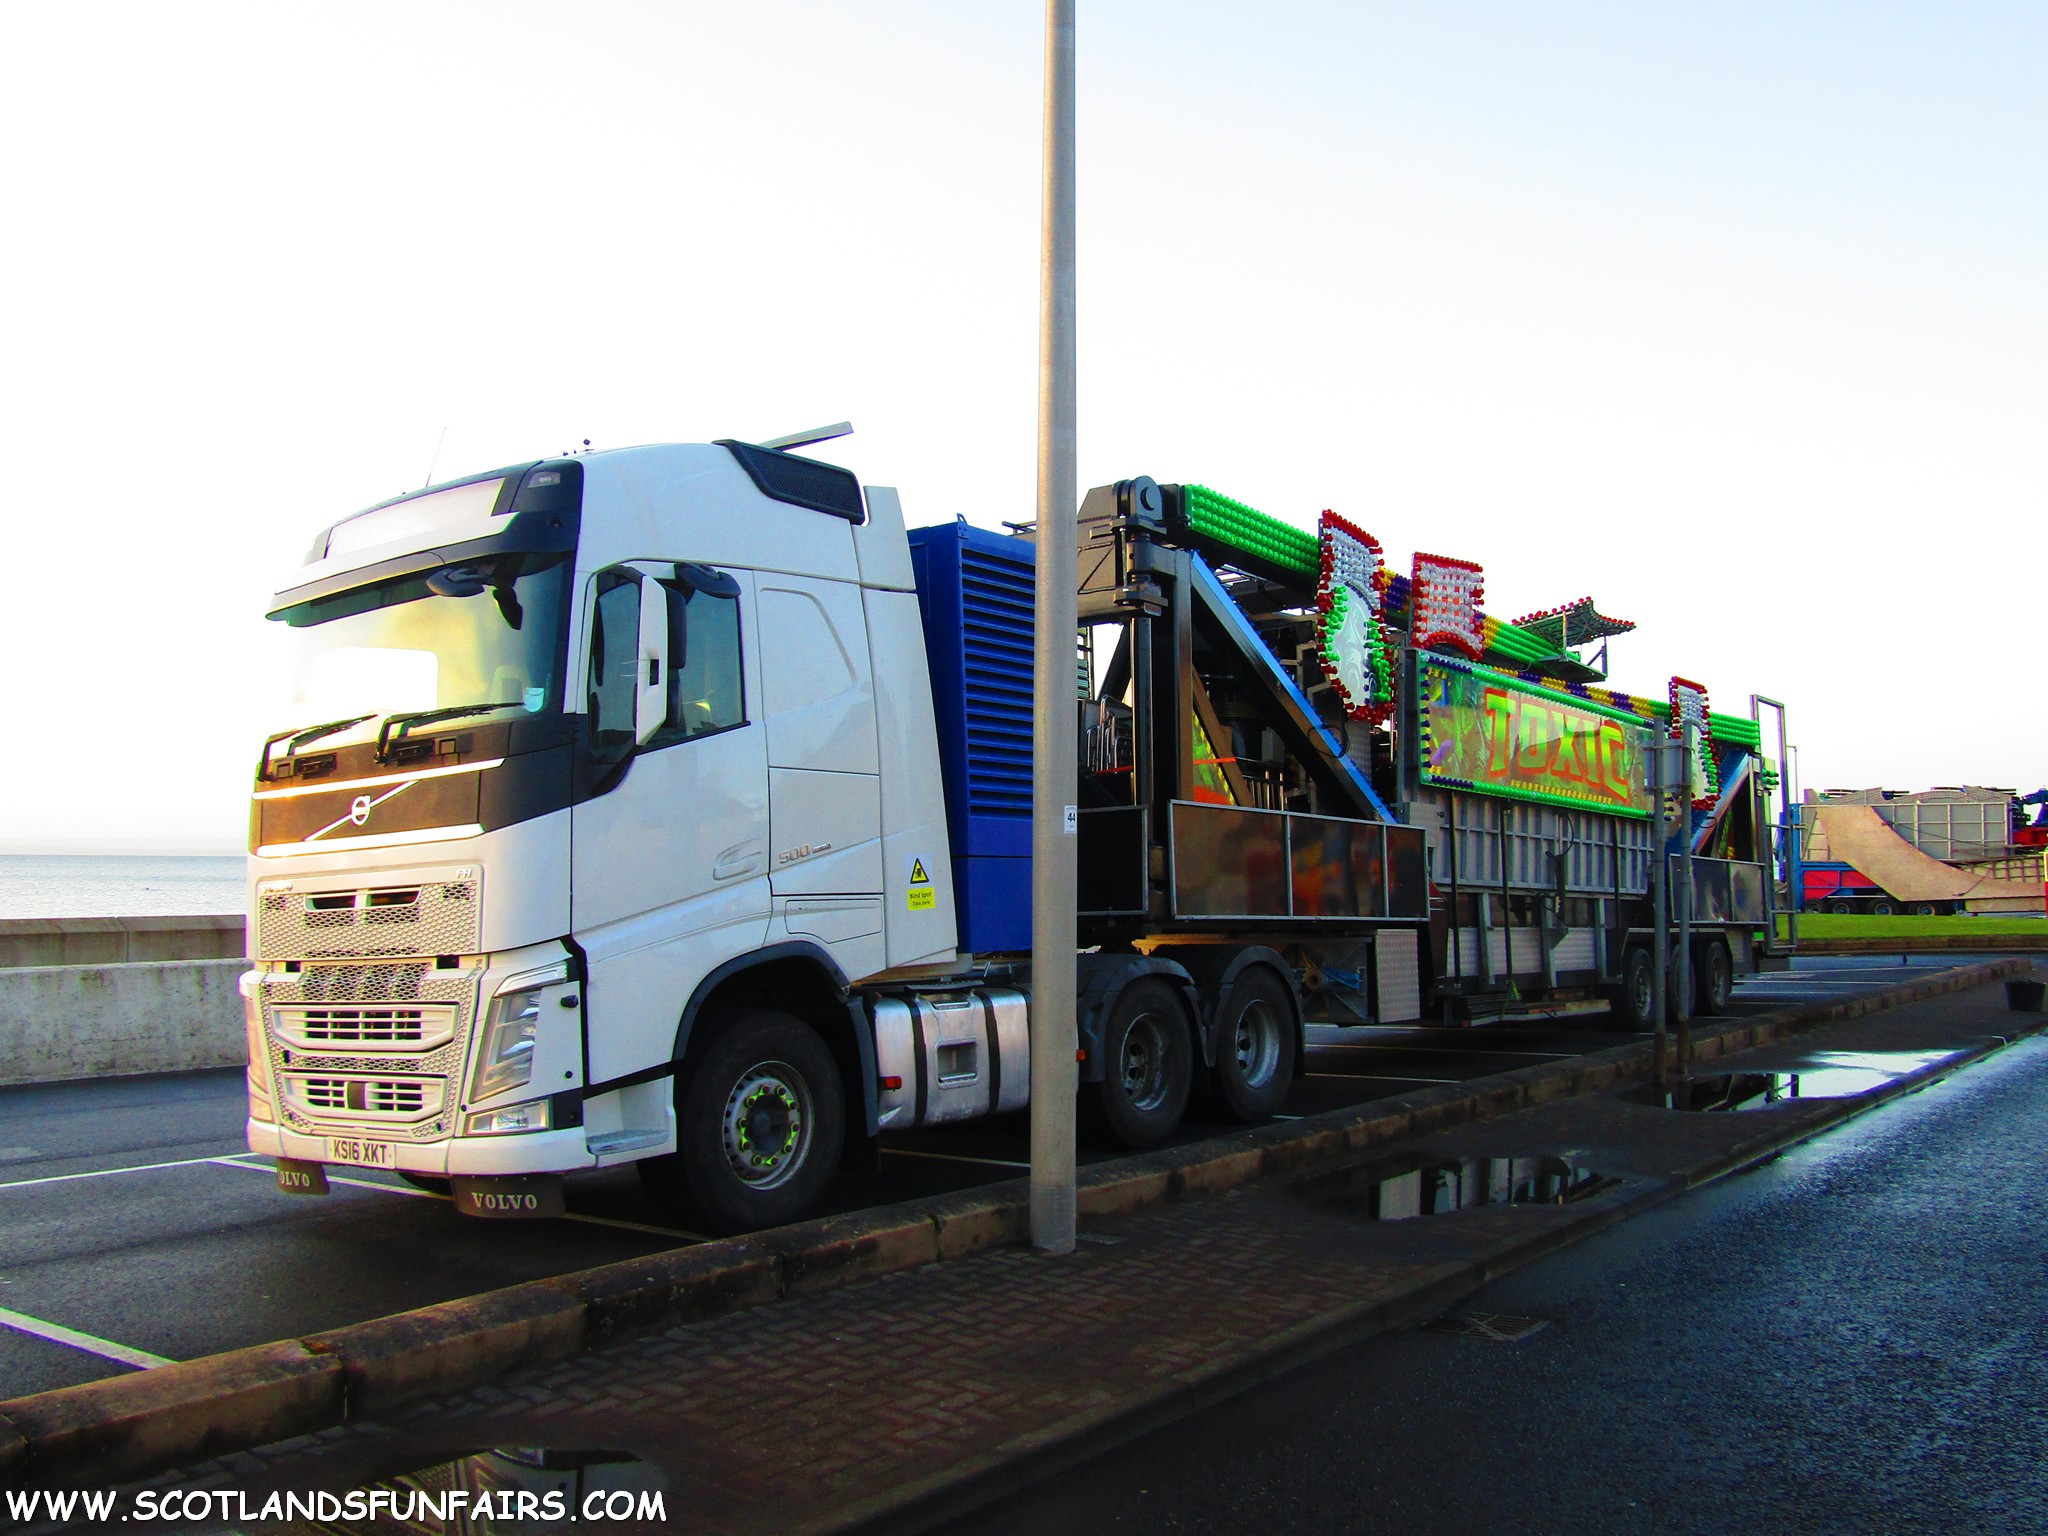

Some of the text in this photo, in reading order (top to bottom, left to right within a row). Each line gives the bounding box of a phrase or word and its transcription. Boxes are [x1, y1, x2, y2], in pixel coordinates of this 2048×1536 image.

[1485, 687, 1630, 804] TOXIC
[778, 844, 810, 864] 500
[456, 868, 472, 879] FH
[333, 1139, 388, 1164] KS16 XKT
[280, 1170, 310, 1188] OLVO
[471, 1191, 538, 1210] VOLVO
